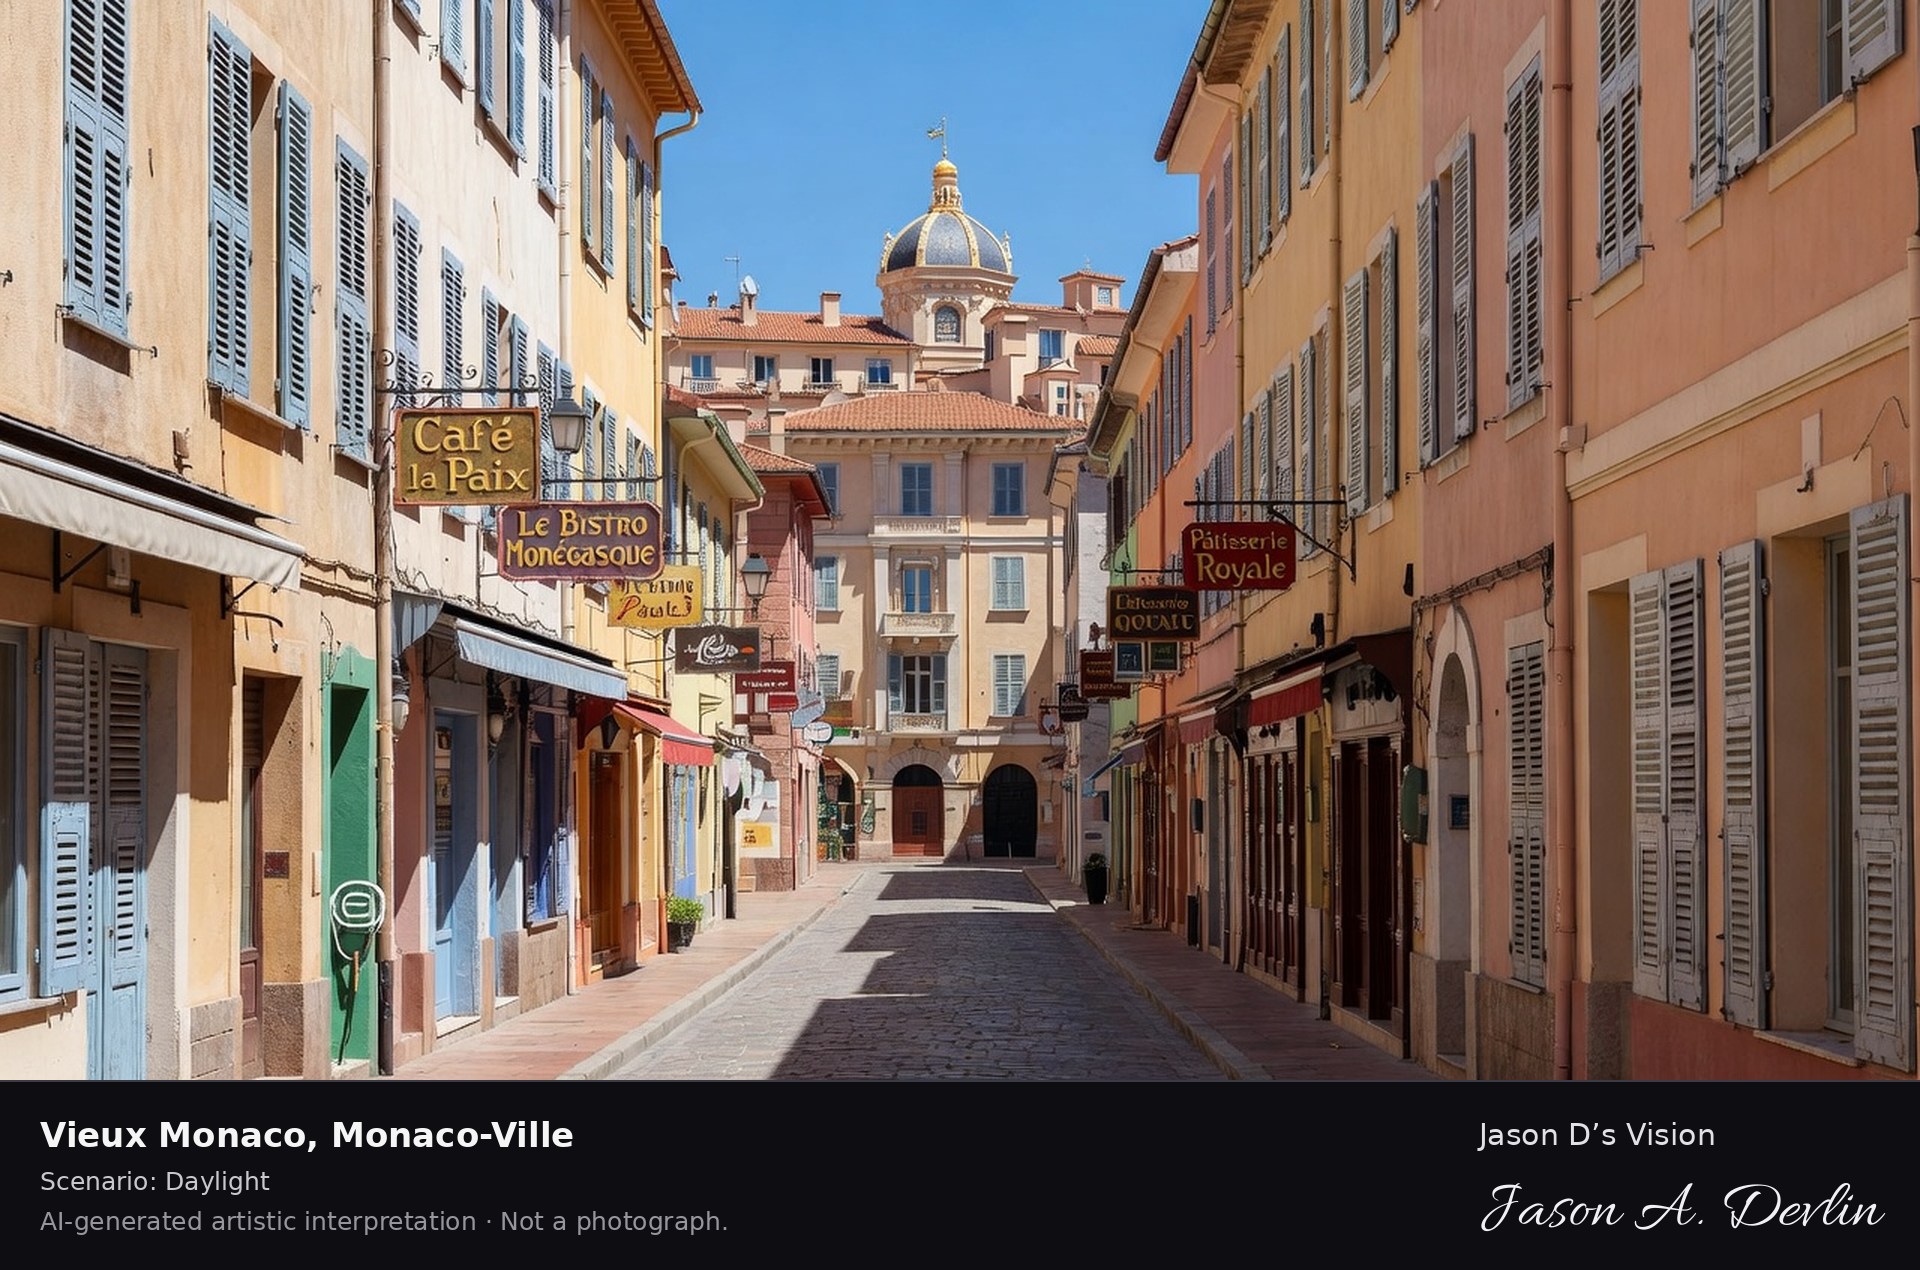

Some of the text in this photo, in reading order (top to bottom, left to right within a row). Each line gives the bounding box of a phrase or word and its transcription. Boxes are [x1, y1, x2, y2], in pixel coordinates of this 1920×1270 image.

[413, 416, 515, 453] Café
[406, 456, 530, 494] la Paix
[518, 510, 550, 537] Le
[1193, 553, 1287, 588] Royale
